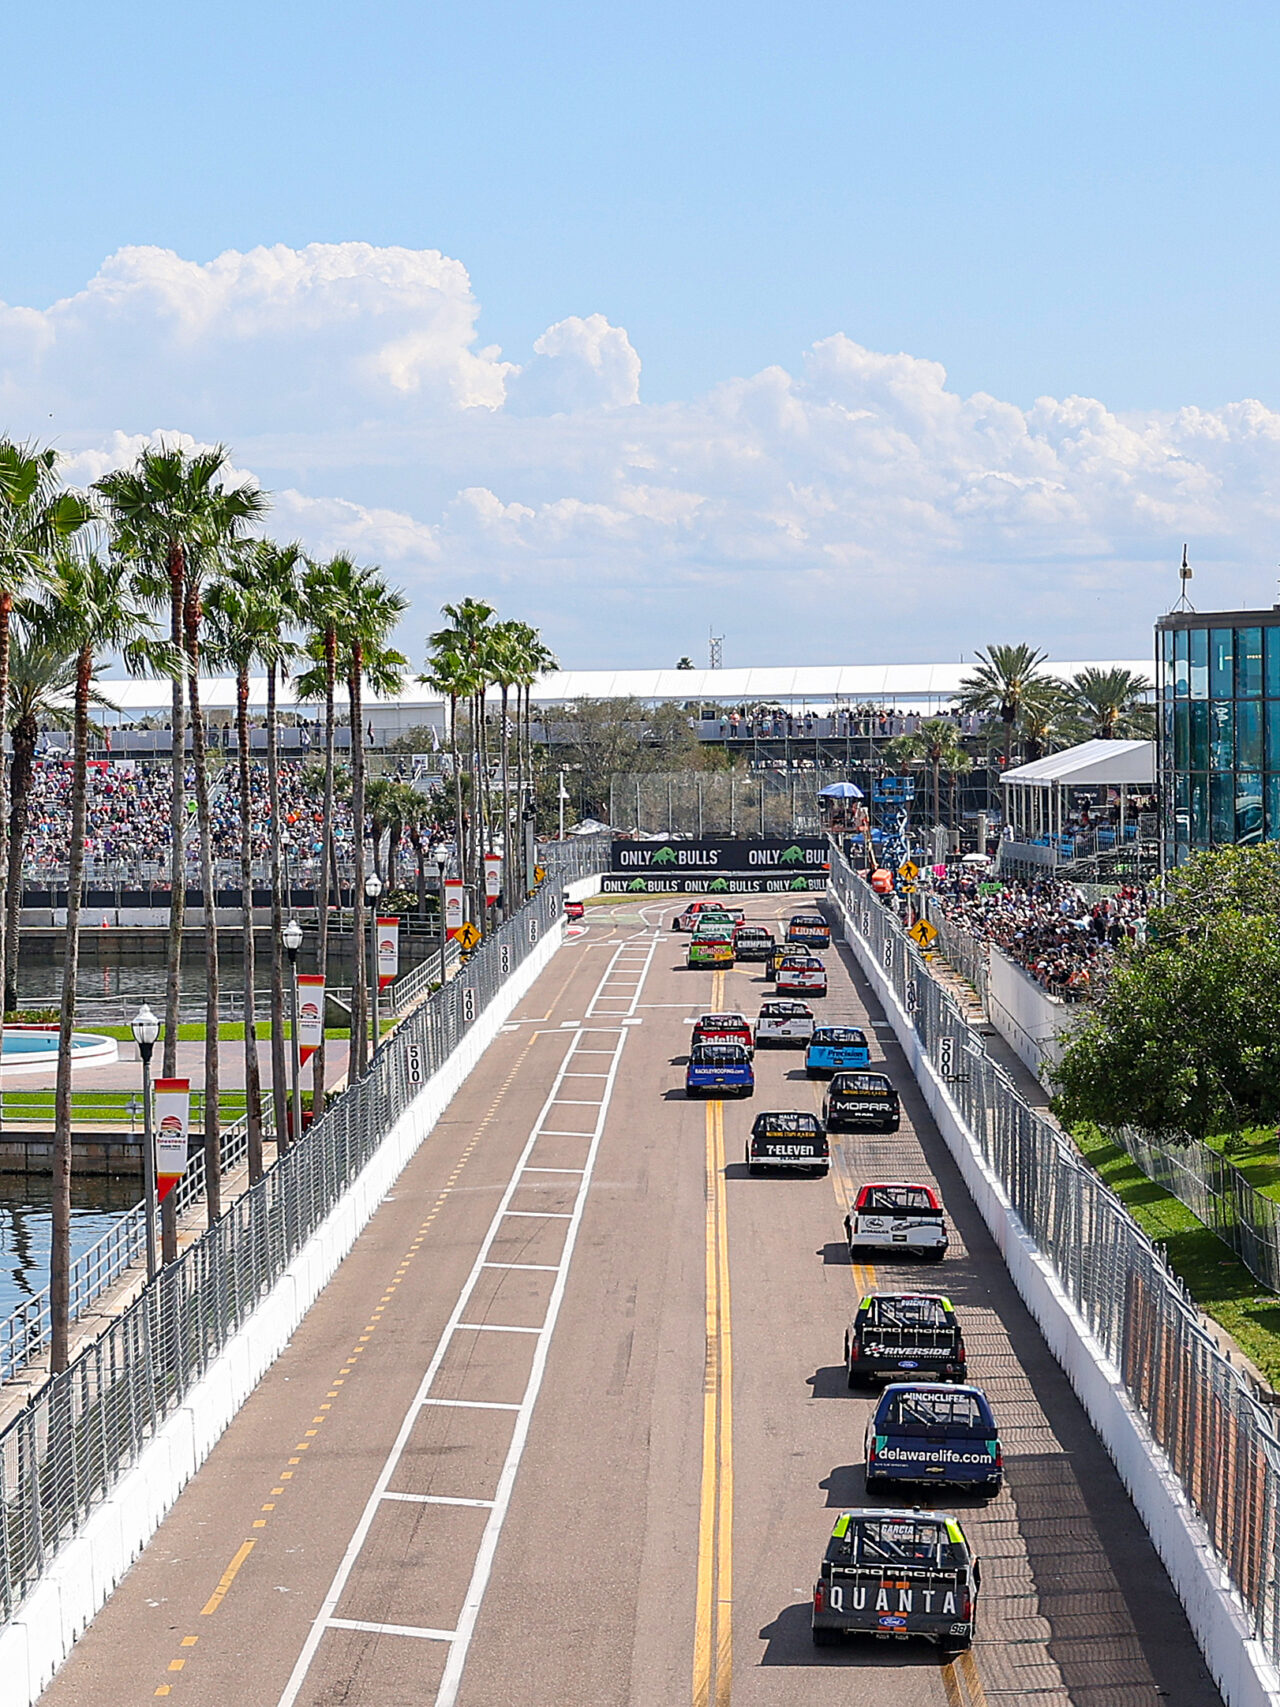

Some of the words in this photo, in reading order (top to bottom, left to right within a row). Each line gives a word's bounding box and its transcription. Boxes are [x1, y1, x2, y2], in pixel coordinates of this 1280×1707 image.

[620, 850, 651, 866] ONLY
[678, 850, 719, 866] BULLS
[748, 849, 780, 865] ONLY
[604, 880, 628, 892] ONLY
[648, 880, 678, 891] BULLS
[685, 880, 709, 892] ONLY
[729, 880, 760, 891] BULLS
[766, 879, 790, 892] ONLY
[501, 946, 509, 973] 300
[884, 939, 892, 967] 300
[906, 981, 915, 1011] 400
[465, 989, 473, 1020] 400
[700, 1034, 746, 1043] Safelite
[410, 1047, 420, 1082] 500
[941, 1038, 951, 1075] 500
[836, 1102, 890, 1112] MOPAR
[884, 1347, 951, 1355] RIVERSIDE
[879, 1448, 992, 1464] delawarelife.com
[881, 1524, 914, 1534] GARCIA
[831, 1567, 883, 1575] FORD
[887, 1570, 957, 1579] RACING
[830, 1586, 956, 1615] QUANTA
[950, 1624, 966, 1635] 98
